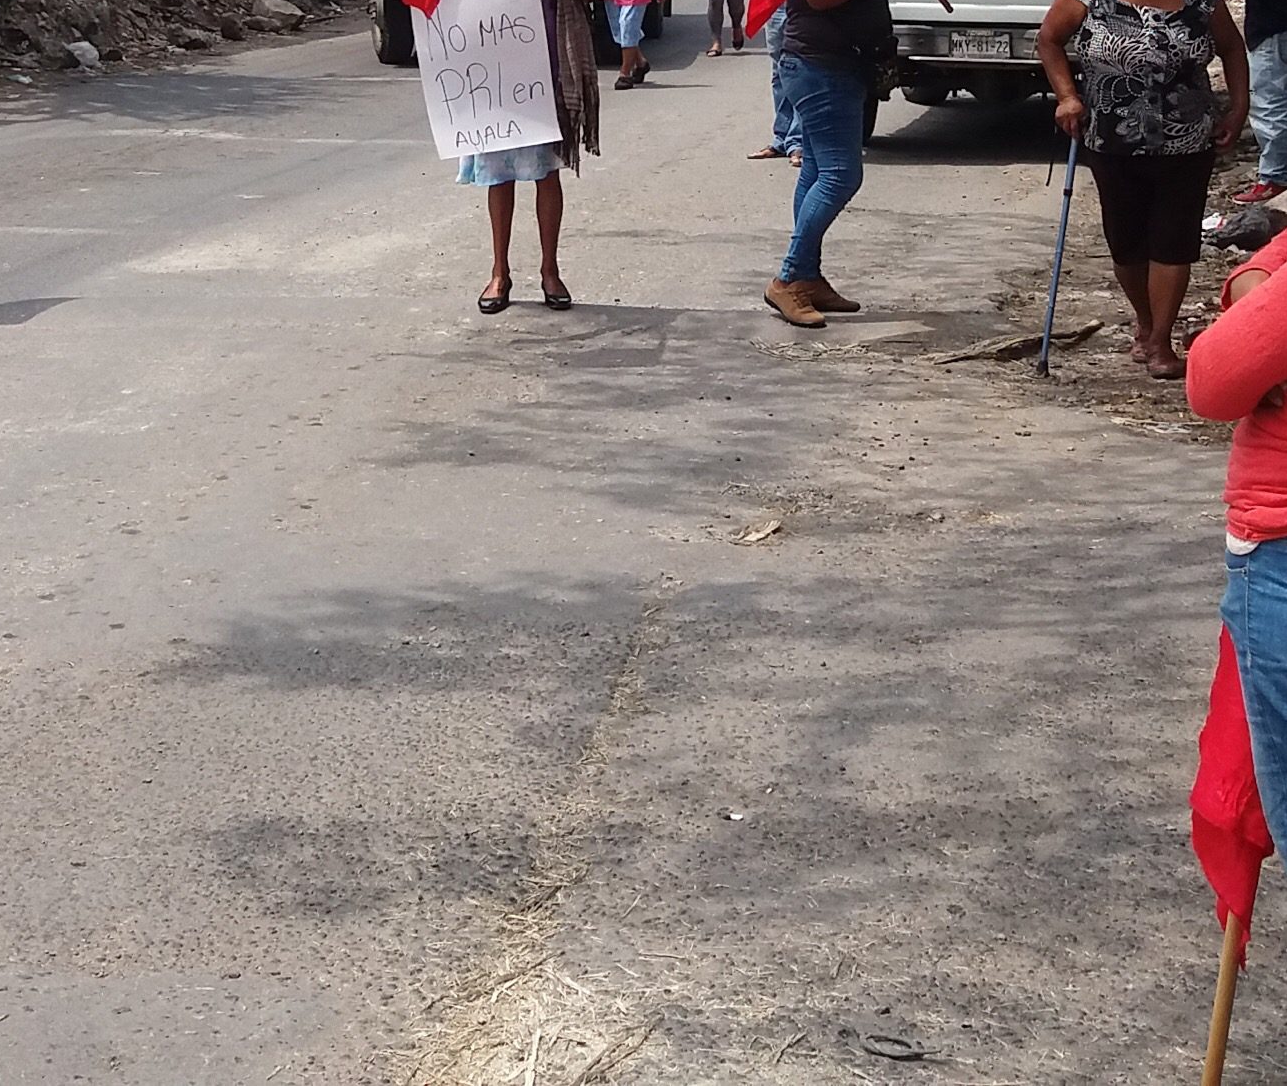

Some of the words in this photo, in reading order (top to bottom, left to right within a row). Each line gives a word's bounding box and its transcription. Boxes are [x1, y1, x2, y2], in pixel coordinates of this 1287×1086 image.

[426, 6, 467, 62] NO
[479, 13, 536, 47] MAS
[952, 39, 1009, 53] MKY-81-22
[435, 62, 503, 126] PRI
[513, 81, 545, 104] en
[455, 120, 522, 152] AYALA
